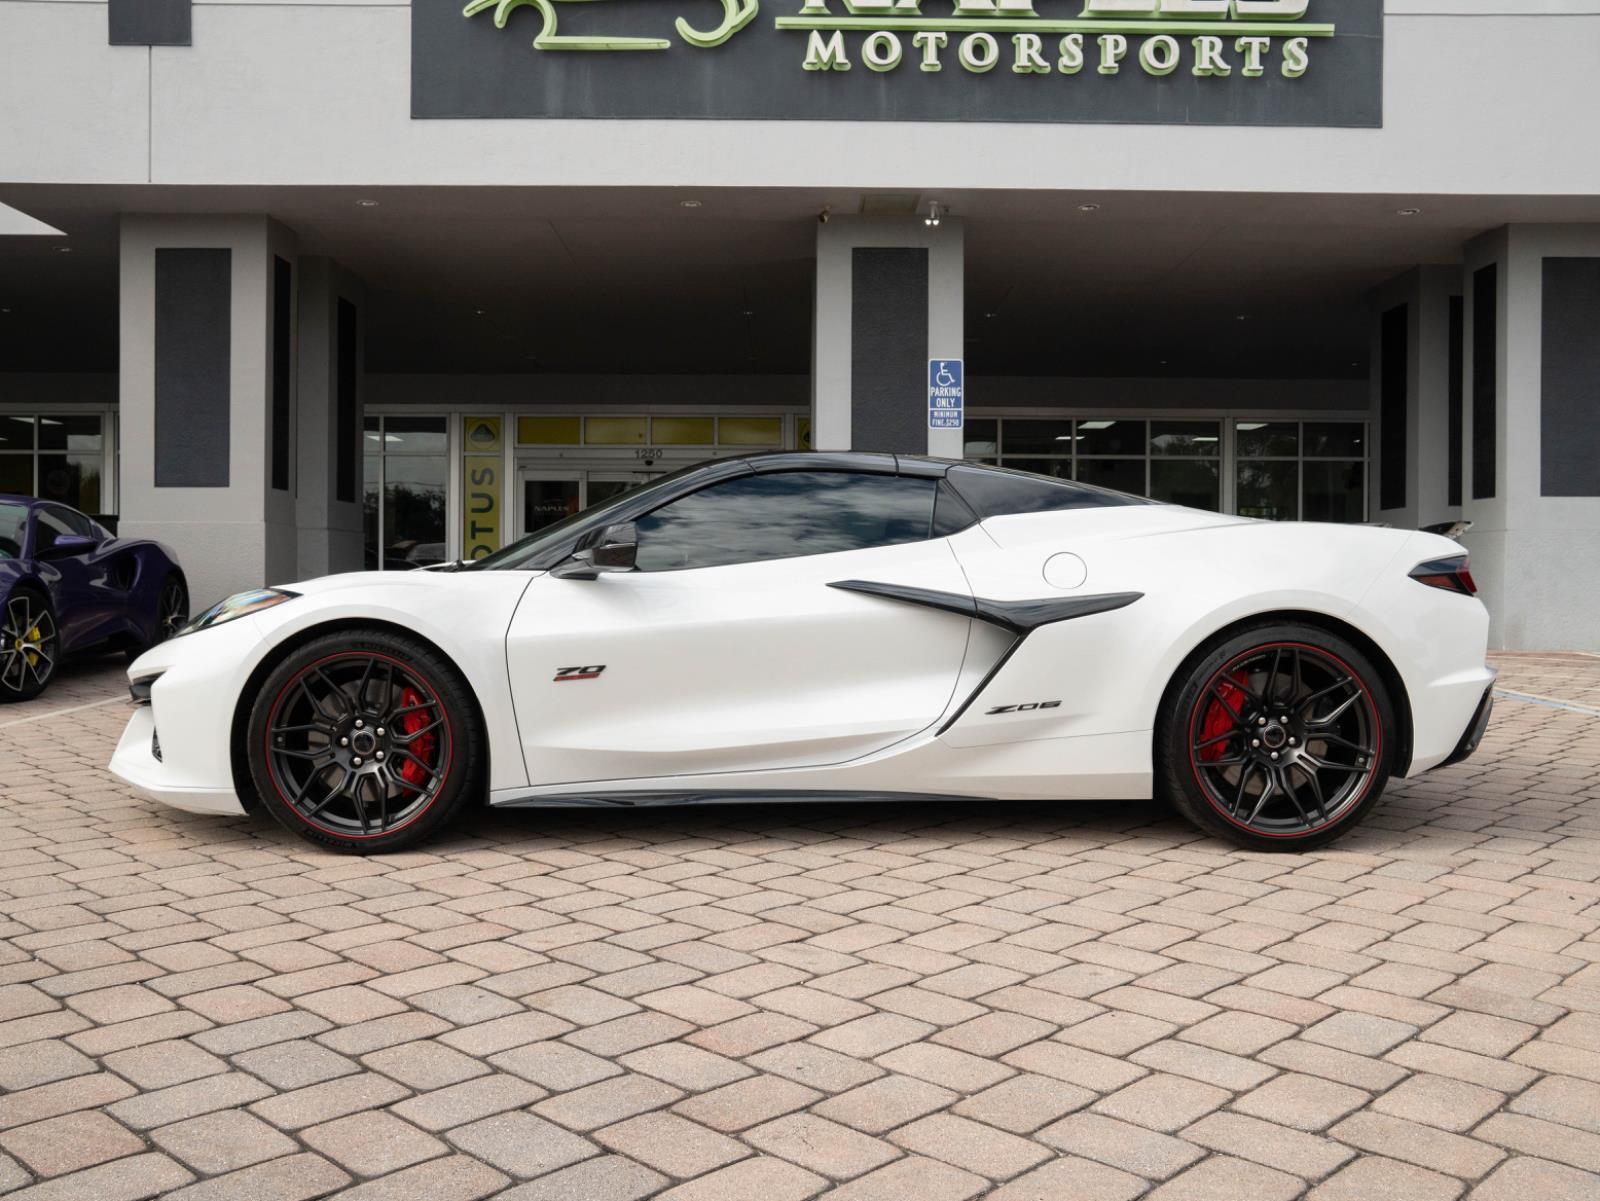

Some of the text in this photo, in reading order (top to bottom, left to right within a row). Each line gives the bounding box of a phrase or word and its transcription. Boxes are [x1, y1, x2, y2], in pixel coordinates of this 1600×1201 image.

[803, 30, 1309, 78] MOTORSPORTS
[930, 386, 961, 397] PARKING
[936, 397, 955, 408] ONLY
[634, 448, 663, 459] 1250
[470, 467, 494, 560] OTUS
